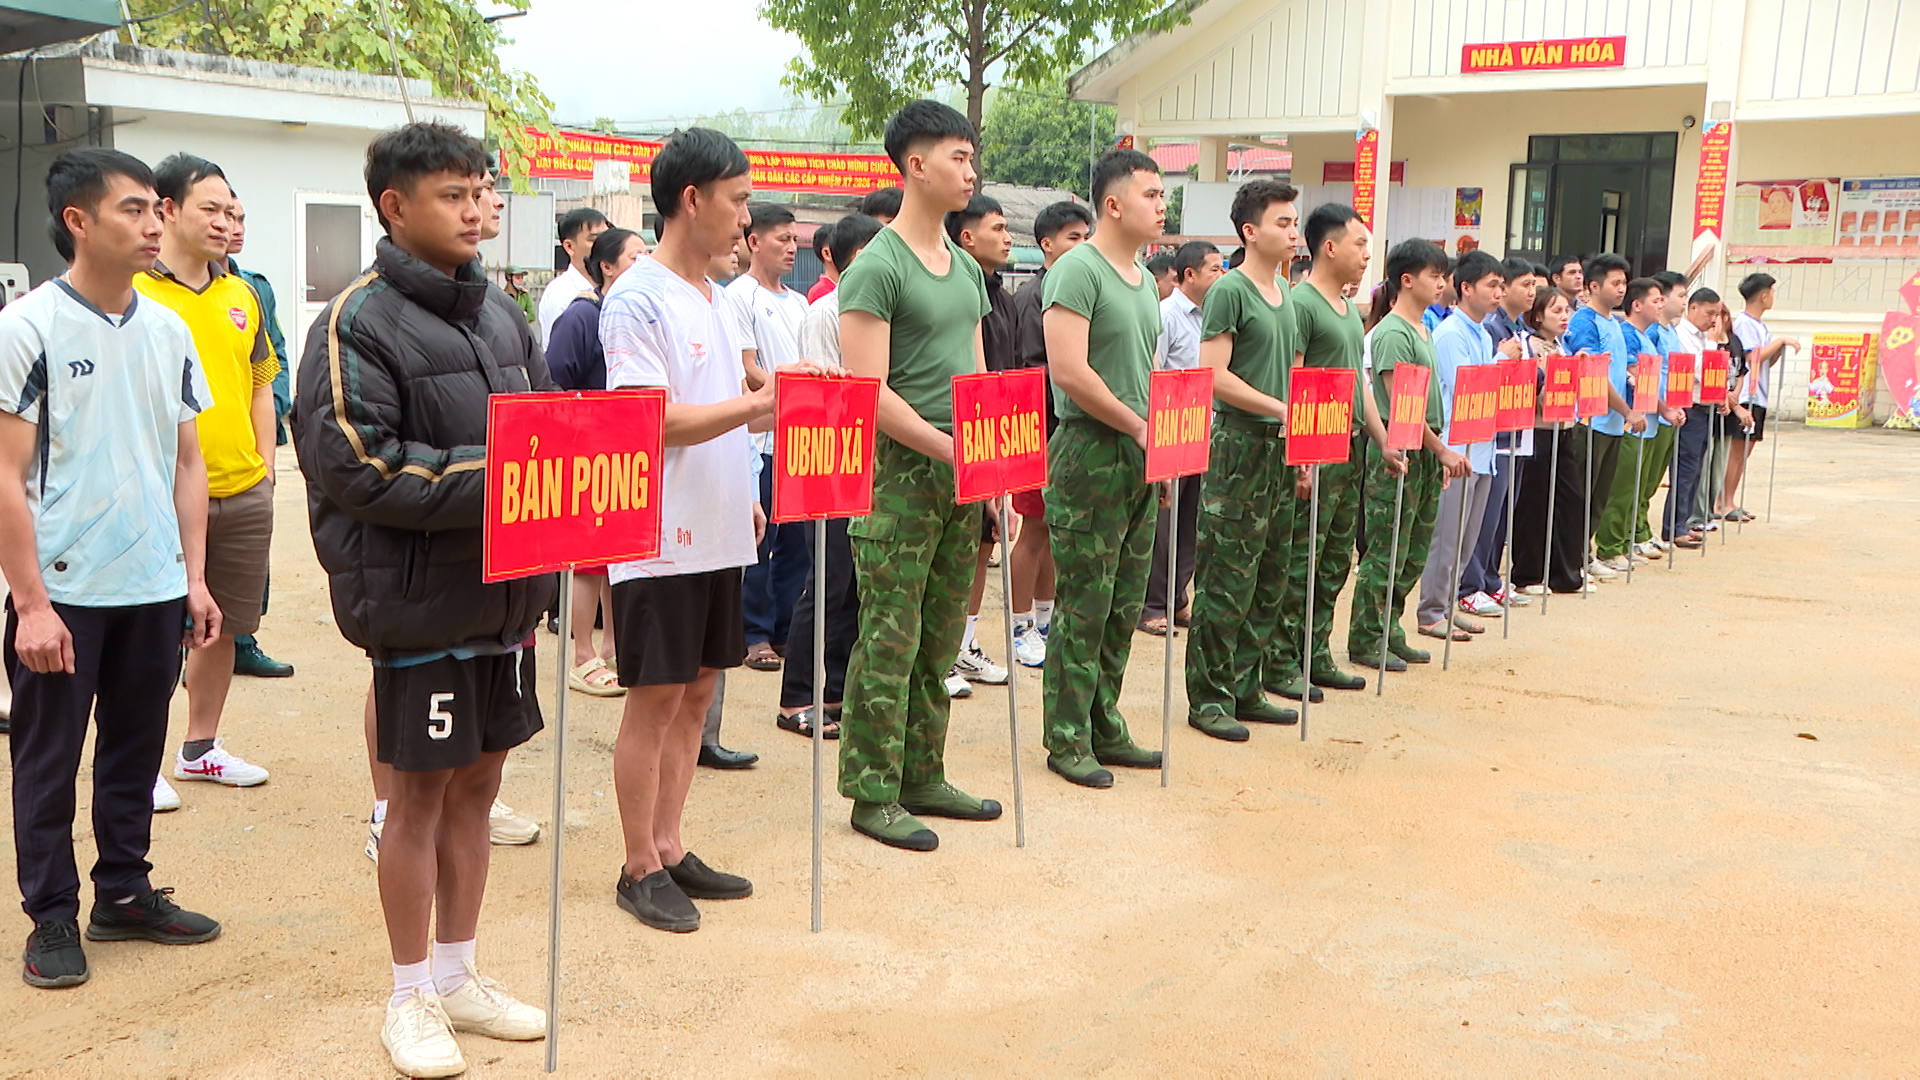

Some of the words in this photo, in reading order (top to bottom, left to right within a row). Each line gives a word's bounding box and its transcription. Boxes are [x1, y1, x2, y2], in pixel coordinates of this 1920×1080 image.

[1470, 44, 1514, 67] NHÀ
[1520, 41, 1564, 65] VĂN
[1570, 39, 1616, 62] HÓA
[576, 156, 593, 171] QUỐ
[1291, 390, 1315, 436] BẢN
[1395, 383, 1412, 423] BẢN
[1454, 383, 1470, 421] BẢN
[1499, 375, 1514, 410] BẢN
[962, 402, 996, 464] BẢN
[1000, 404, 1040, 458] SÁNG
[1154, 394, 1179, 448] BẢN
[1181, 397, 1206, 444] CÚM
[786, 426, 836, 477] UBND
[839, 417, 864, 474] XÃ
[501, 434, 564, 525] BẢN
[571, 450, 650, 527] PỌNG
[428, 692, 455, 741] 5
